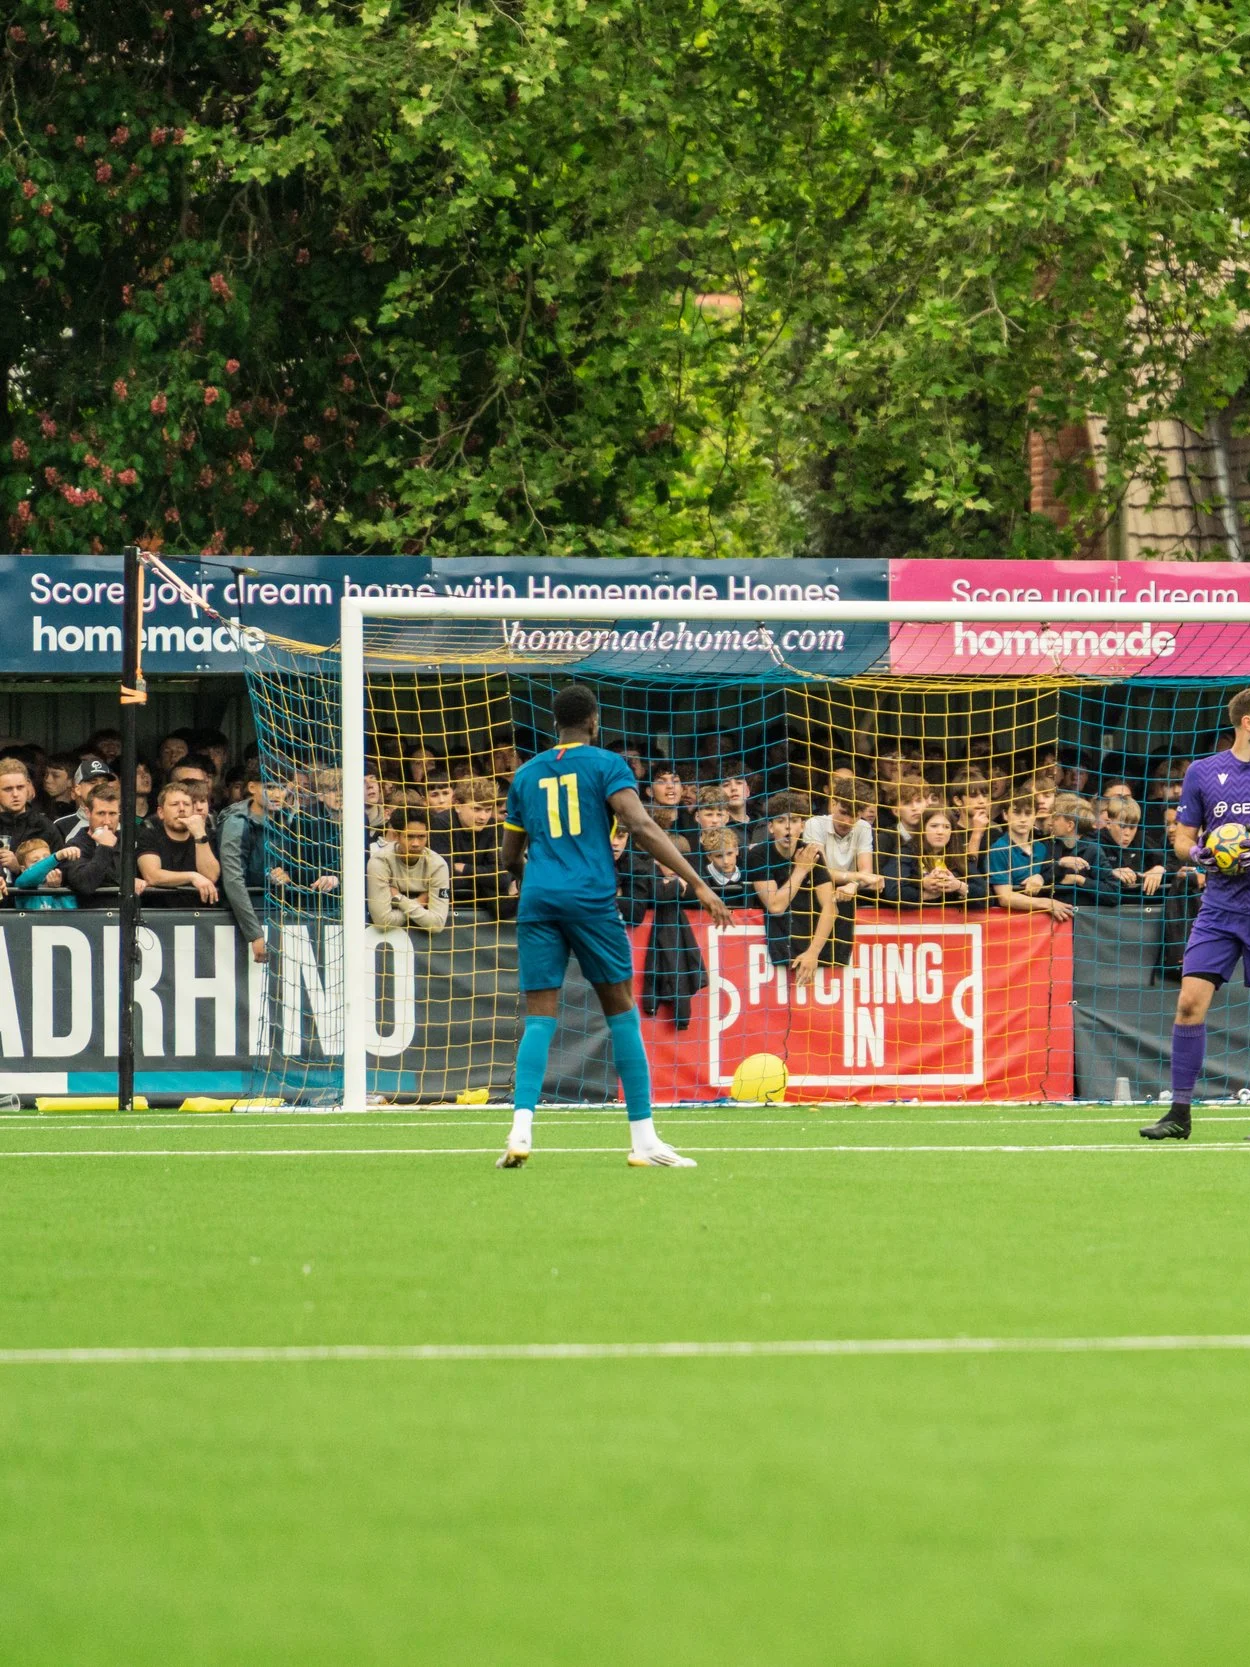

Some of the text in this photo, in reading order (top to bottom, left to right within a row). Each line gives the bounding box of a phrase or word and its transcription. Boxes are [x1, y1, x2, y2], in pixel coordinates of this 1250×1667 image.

[30, 573, 124, 604] Score
[223, 574, 333, 605] dream
[344, 575, 436, 598] home
[444, 576, 516, 599] with
[527, 576, 718, 600] Homemade
[728, 576, 840, 601] Homes
[952, 579, 1042, 602] Score
[1136, 581, 1239, 602] dream
[33, 616, 266, 651] hommade
[955, 621, 1176, 656] homemade
[538, 772, 582, 839] 11
[749, 942, 944, 1005] PICHING
[843, 1006, 885, 1068] IN
